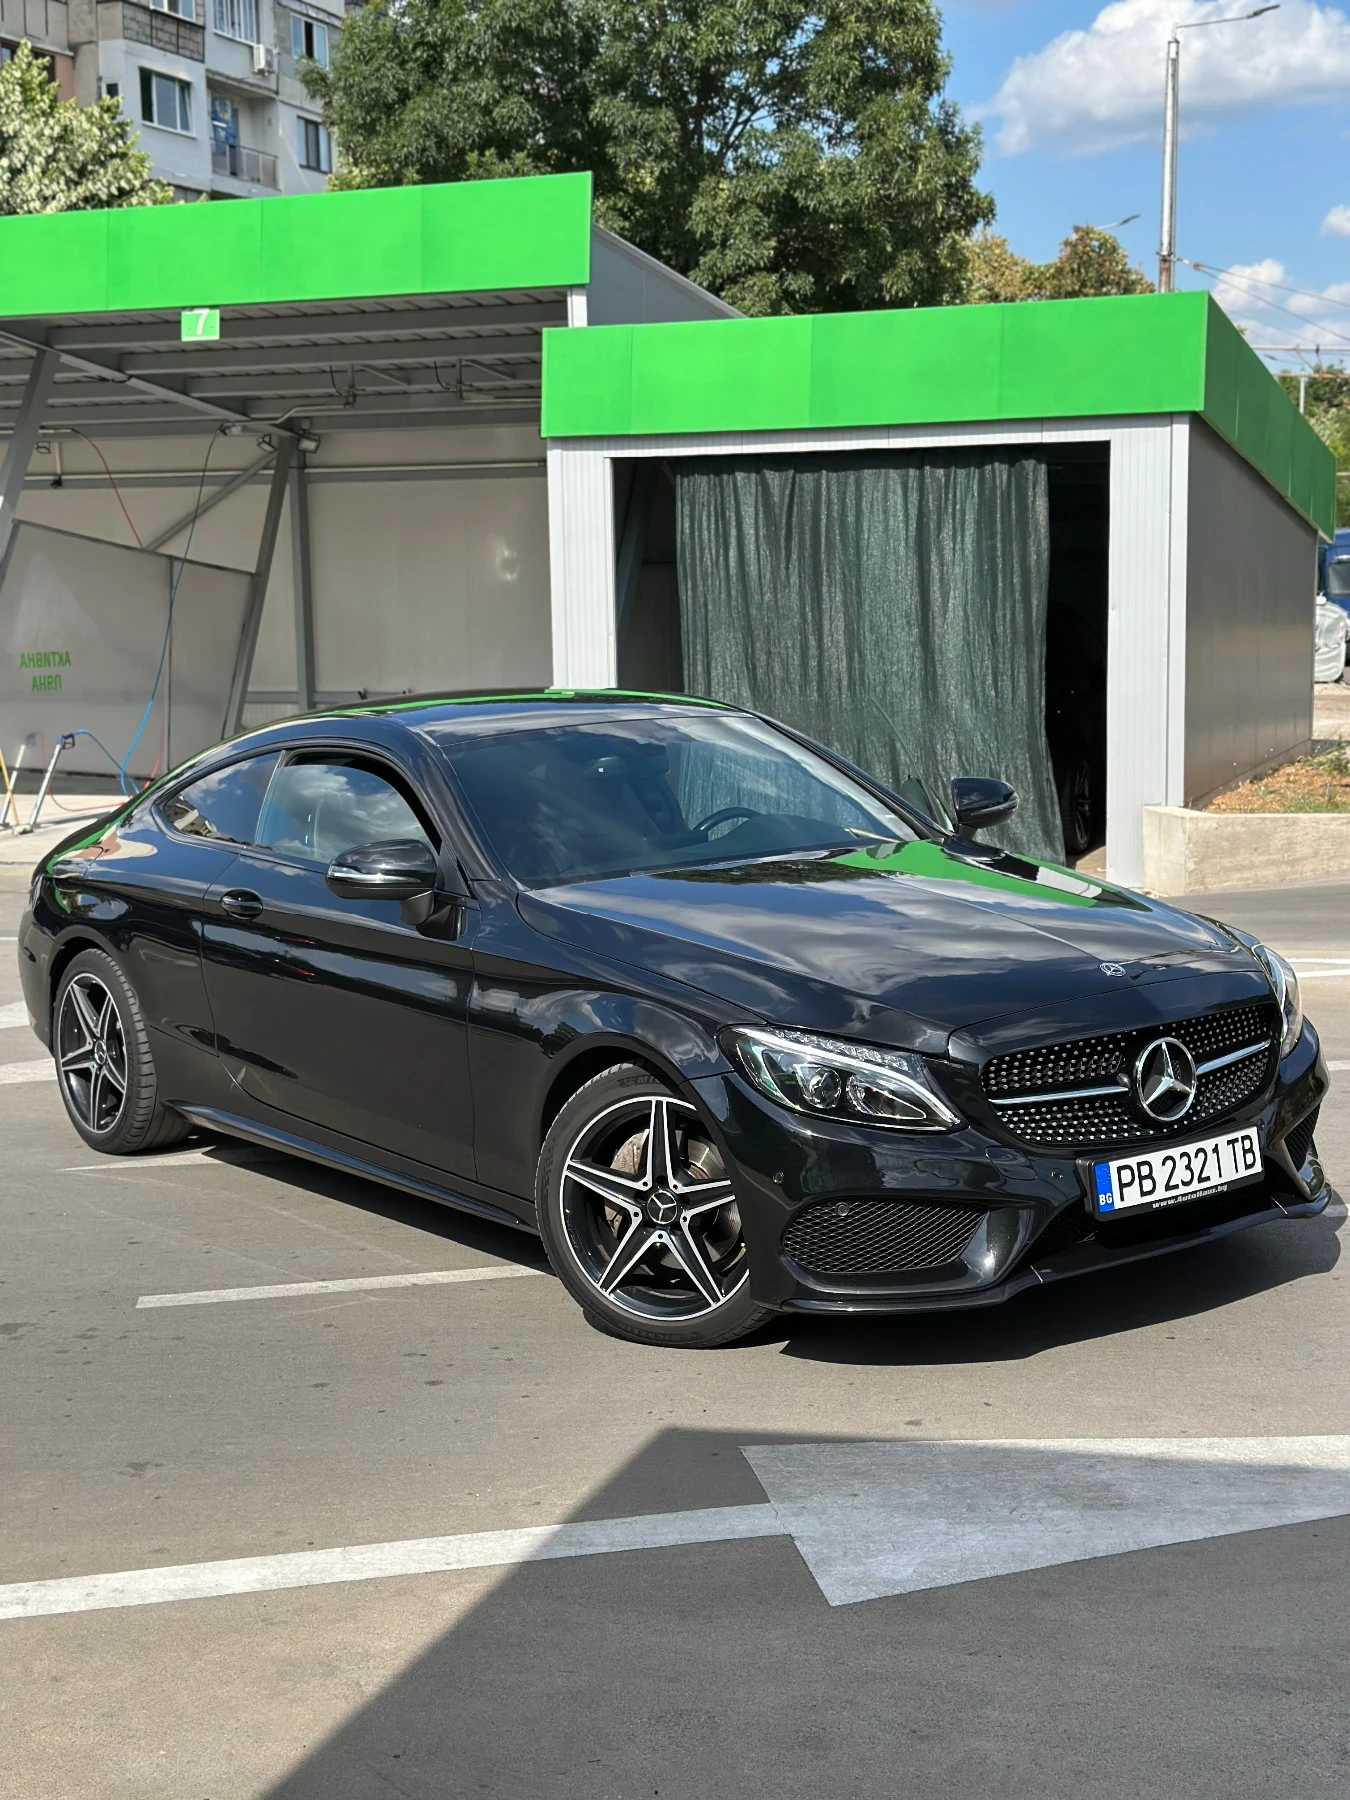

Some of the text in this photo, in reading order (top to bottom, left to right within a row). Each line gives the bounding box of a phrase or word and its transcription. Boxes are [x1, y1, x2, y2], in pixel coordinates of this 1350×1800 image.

[192, 308, 210, 336] 7
[1116, 1134, 1257, 1202] PB 2321 TB
[1099, 1193, 1113, 1205] BG
